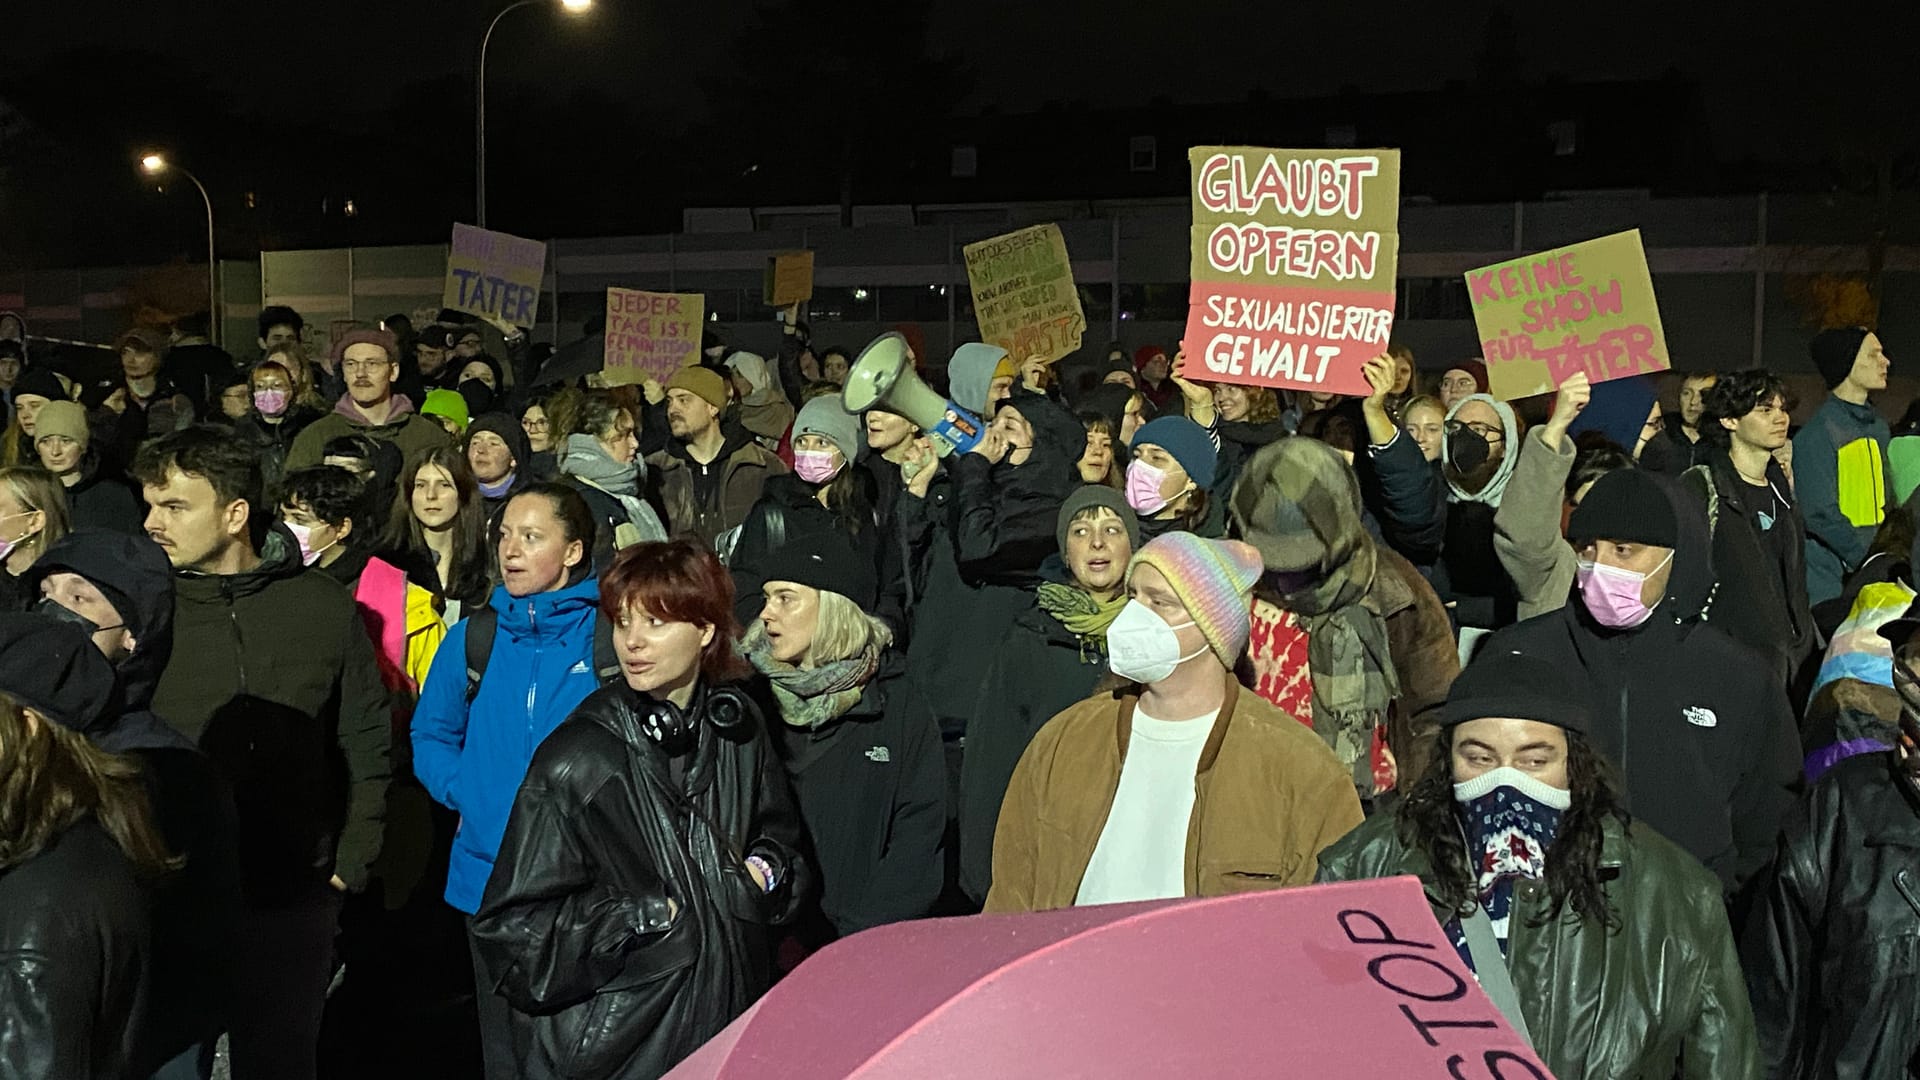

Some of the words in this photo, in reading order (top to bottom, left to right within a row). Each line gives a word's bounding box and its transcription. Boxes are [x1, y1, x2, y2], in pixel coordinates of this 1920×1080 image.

[1199, 153, 1379, 219] GLAUBT
[1208, 222, 1380, 280] OPFERN
[609, 292, 682, 315] JEDER
[1469, 252, 1584, 305] KEINE
[610, 315, 651, 337] TAG
[660, 320, 691, 338] IST
[1202, 295, 1394, 345] SEXUALISIERTER
[1521, 279, 1623, 334] SHOW
[1204, 333, 1341, 383] GEWALT
[1483, 328, 1534, 366] FÜR
[1529, 324, 1667, 390] TÄTER
